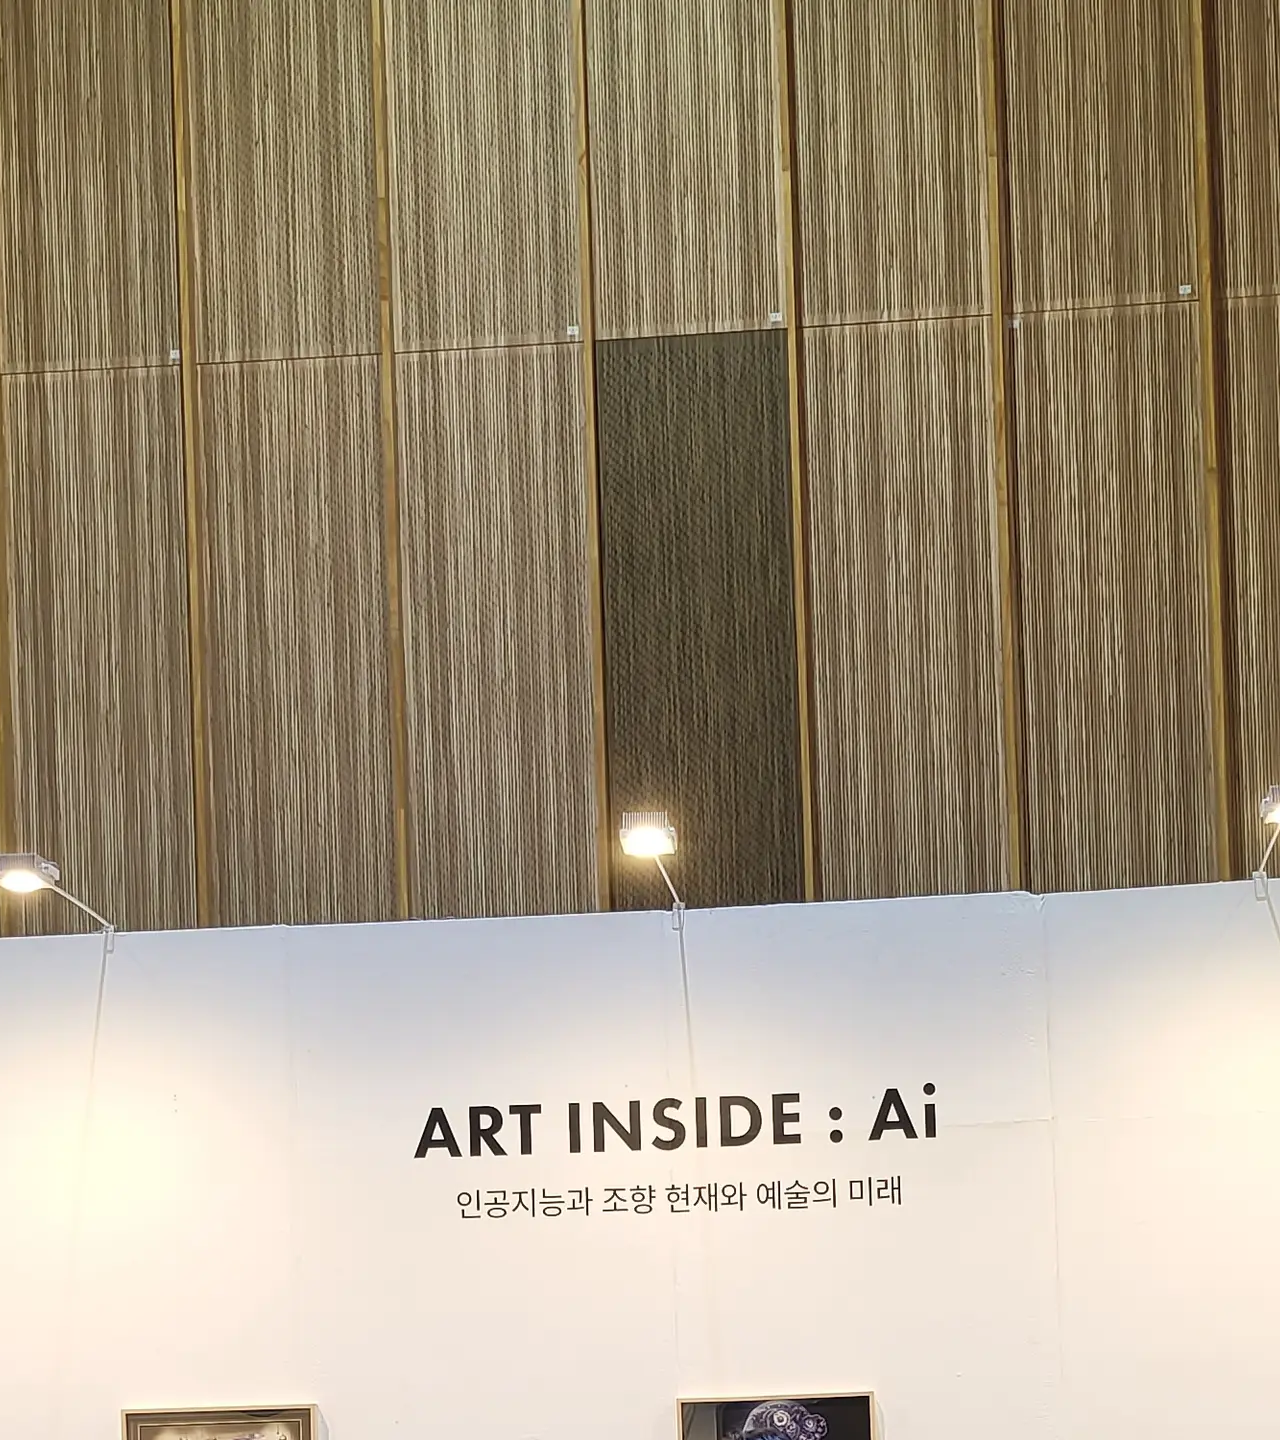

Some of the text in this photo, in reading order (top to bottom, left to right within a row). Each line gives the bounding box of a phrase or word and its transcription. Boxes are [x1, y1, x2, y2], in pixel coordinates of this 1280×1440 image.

[414, 1103, 542, 1159] ART
[568, 1092, 803, 1154] INSIDE
[868, 1082, 938, 1142] Ai
[456, 1175, 903, 1219] 인공지능과 조향 현재와 예술의 미래
